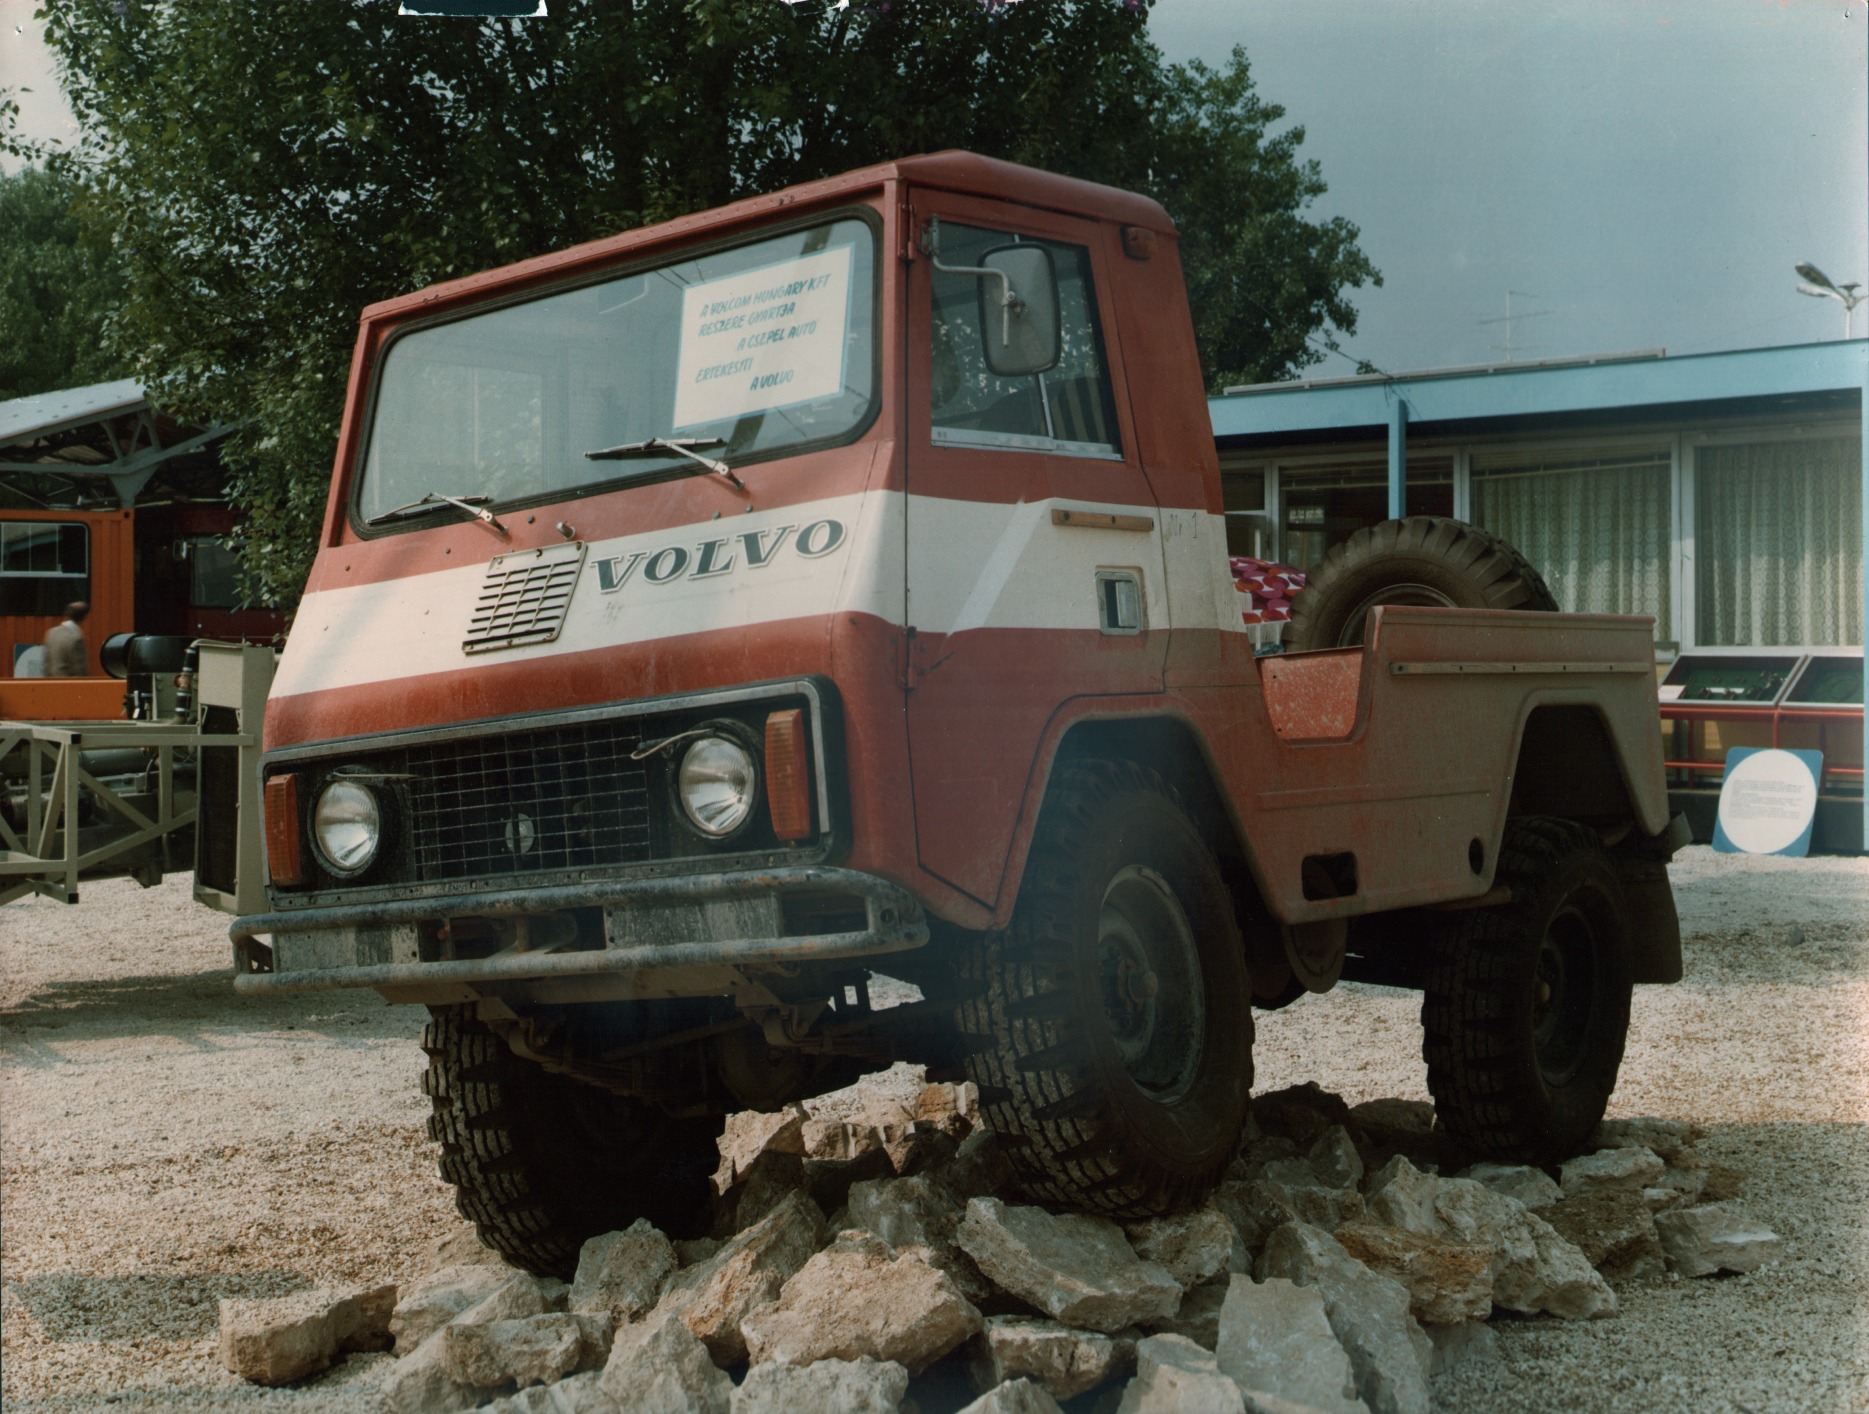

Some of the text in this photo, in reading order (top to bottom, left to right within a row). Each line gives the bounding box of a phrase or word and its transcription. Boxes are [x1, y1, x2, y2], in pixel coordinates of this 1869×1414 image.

[700, 273, 832, 318] A VOLCOM HUNGARY KFT
[737, 337, 746, 352] A
[747, 328, 785, 349] CSEPEL
[749, 369, 795, 391] A VOLVO
[590, 519, 846, 594] VOLVO
